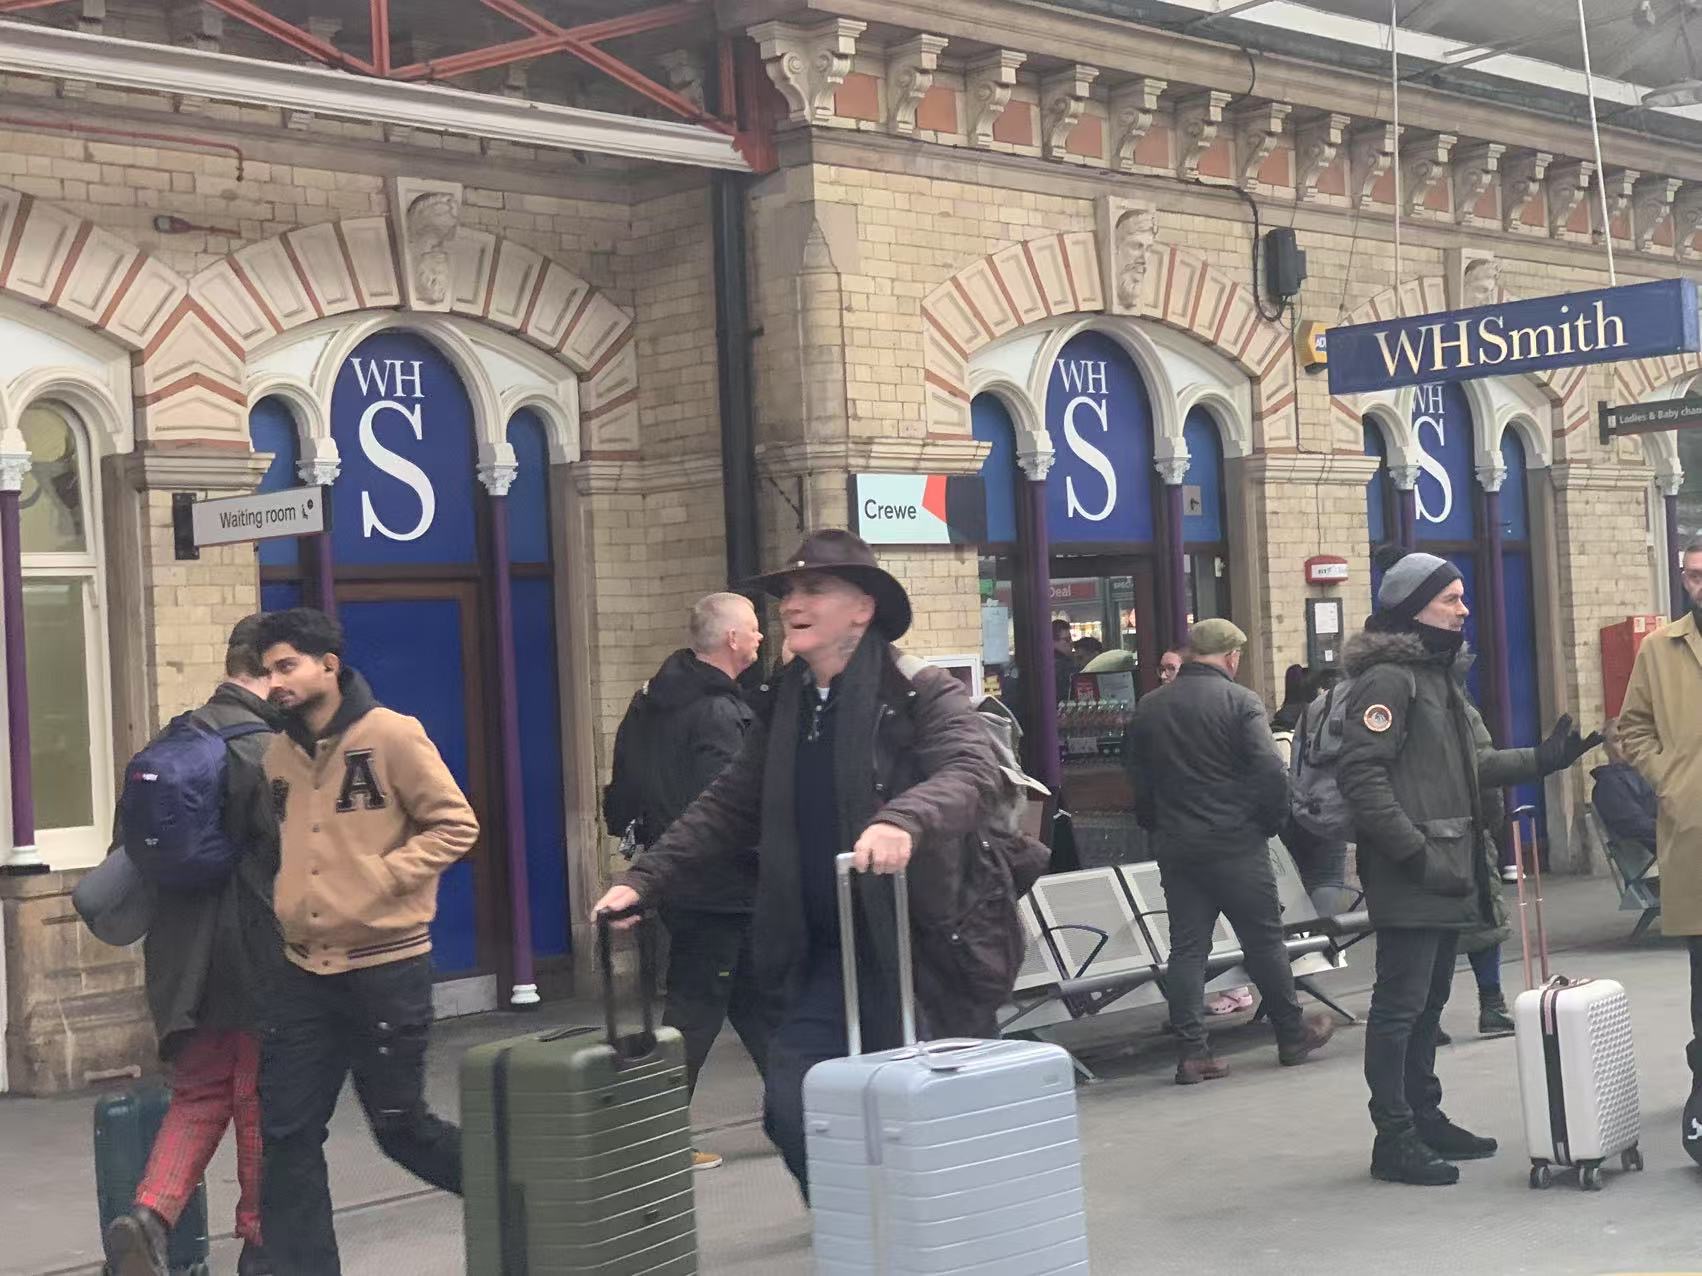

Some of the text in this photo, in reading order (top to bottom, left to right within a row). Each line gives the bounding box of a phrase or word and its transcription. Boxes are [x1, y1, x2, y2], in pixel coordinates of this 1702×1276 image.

[350, 357, 424, 398] WH
[1057, 359, 1109, 394] WH
[1619, 413, 1647, 425] Ladies
[1648, 411, 1656, 421] &
[1657, 408, 1679, 420] Baby
[358, 400, 436, 541] S
[1063, 396, 1117, 522] S
[1411, 415, 1453, 524] S
[219, 506, 296, 529] Waiting room
[864, 498, 917, 520] Crewe
[335, 748, 386, 813] A
